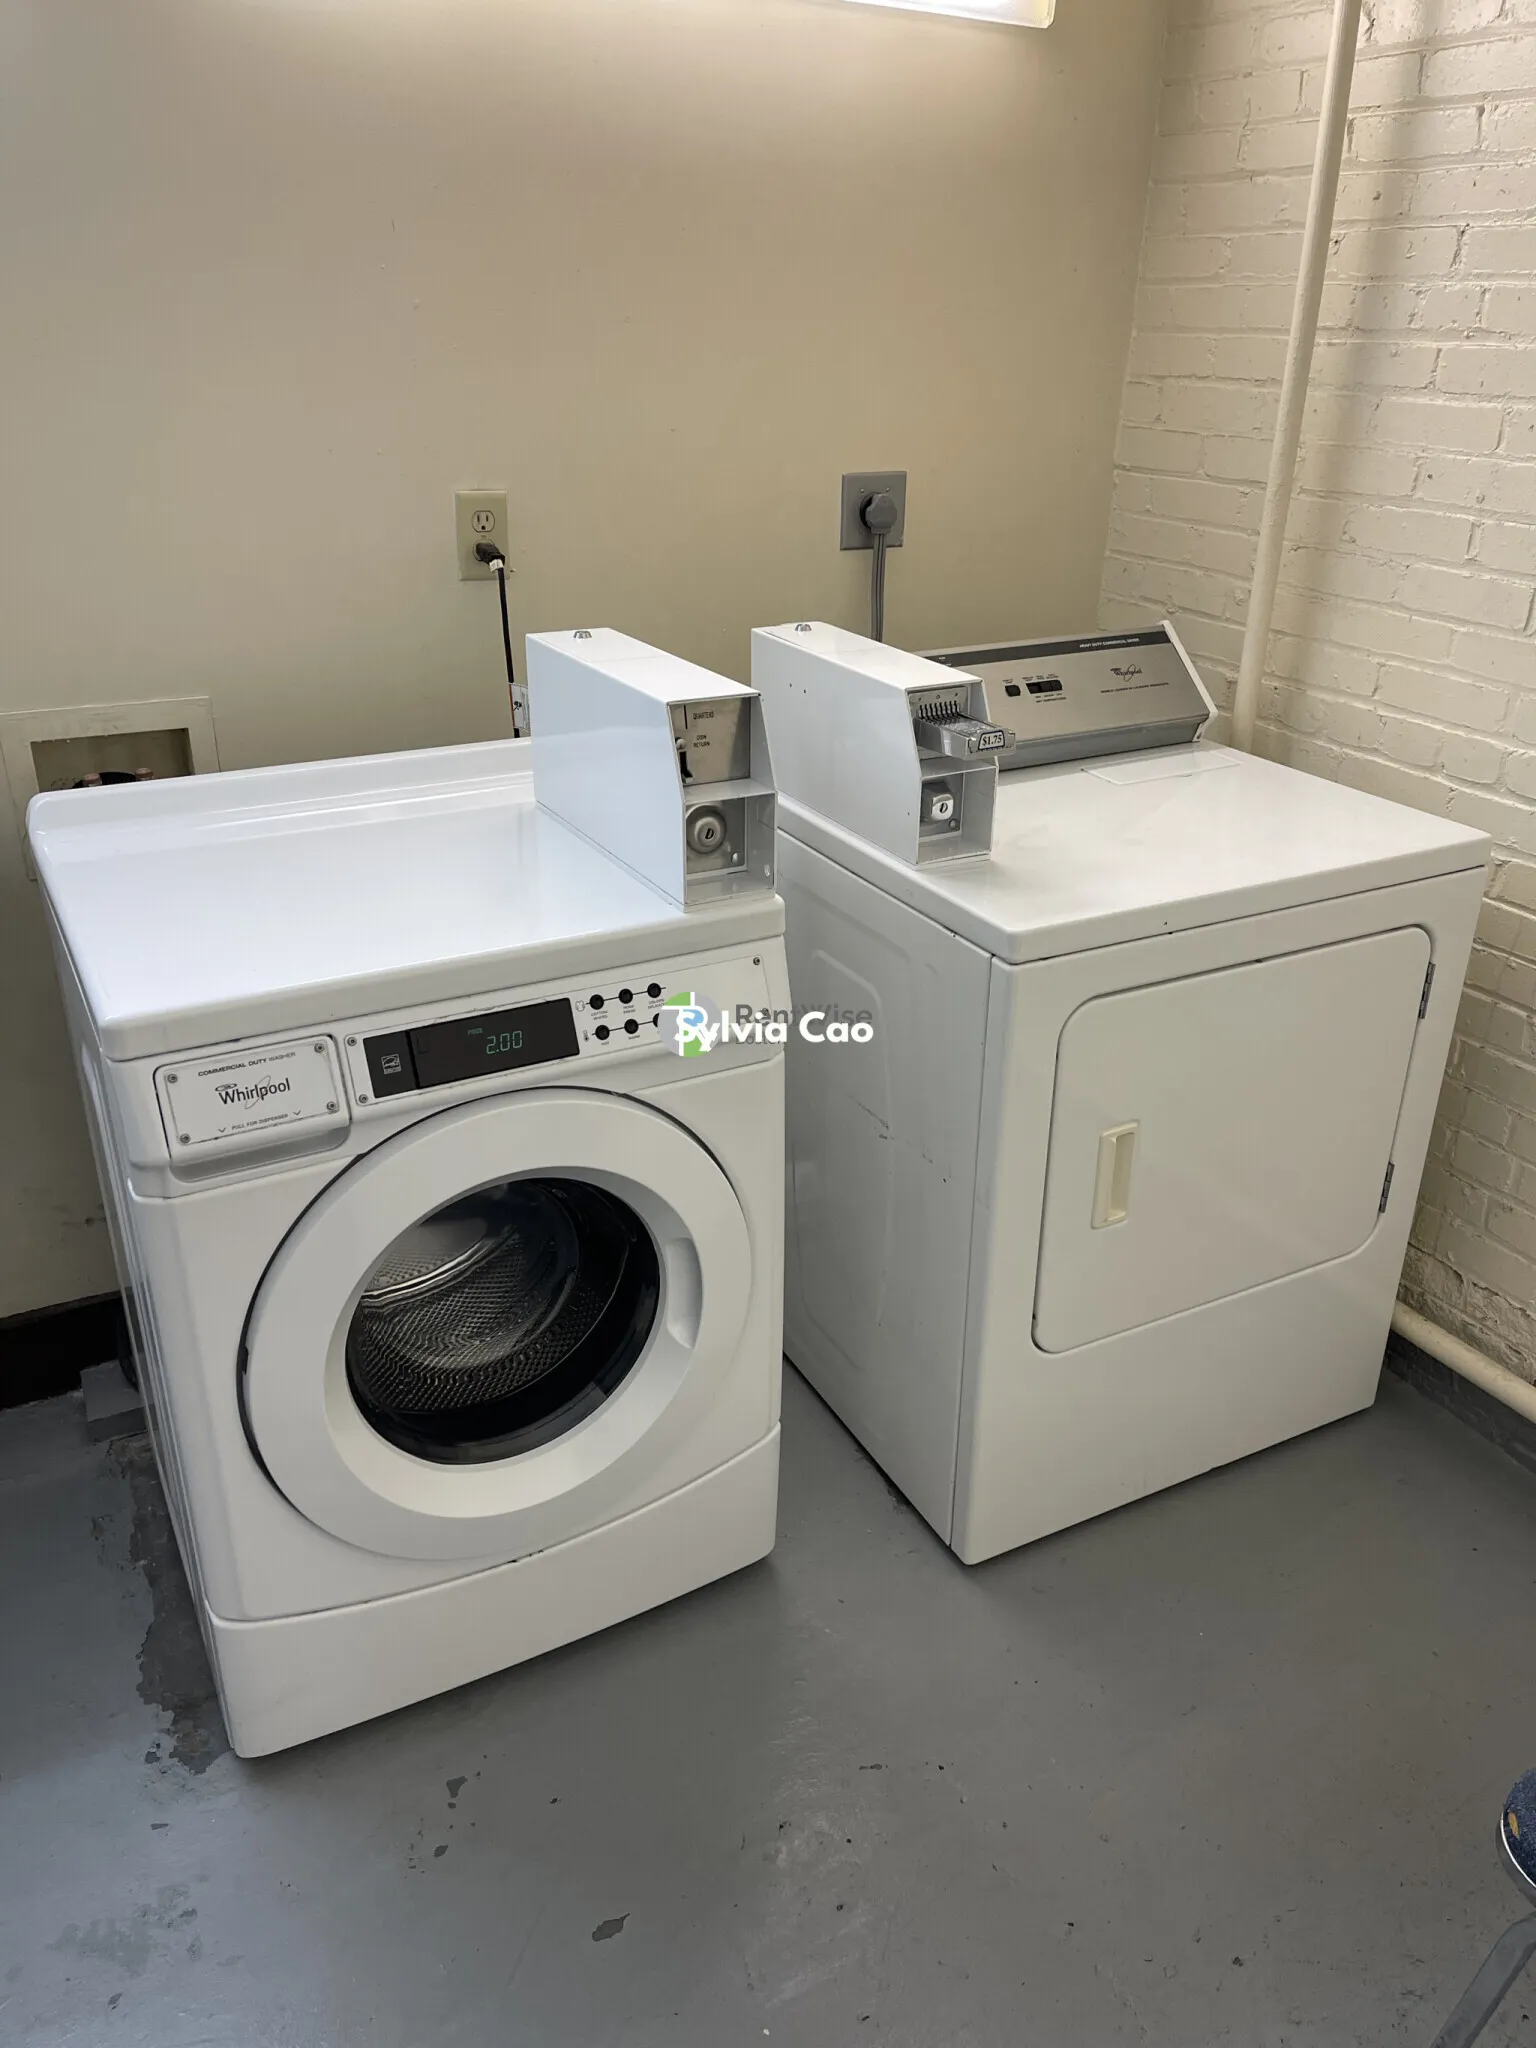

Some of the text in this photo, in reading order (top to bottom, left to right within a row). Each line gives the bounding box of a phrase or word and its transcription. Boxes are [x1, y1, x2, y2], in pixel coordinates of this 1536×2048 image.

[982, 735, 1002, 747] $1.75
[486, 1030, 523, 1055] 2.00
[197, 1062, 246, 1076] COMMERCIAL
[247, 1057, 267, 1067] DUTY
[218, 1077, 291, 1105] Whirlpool
